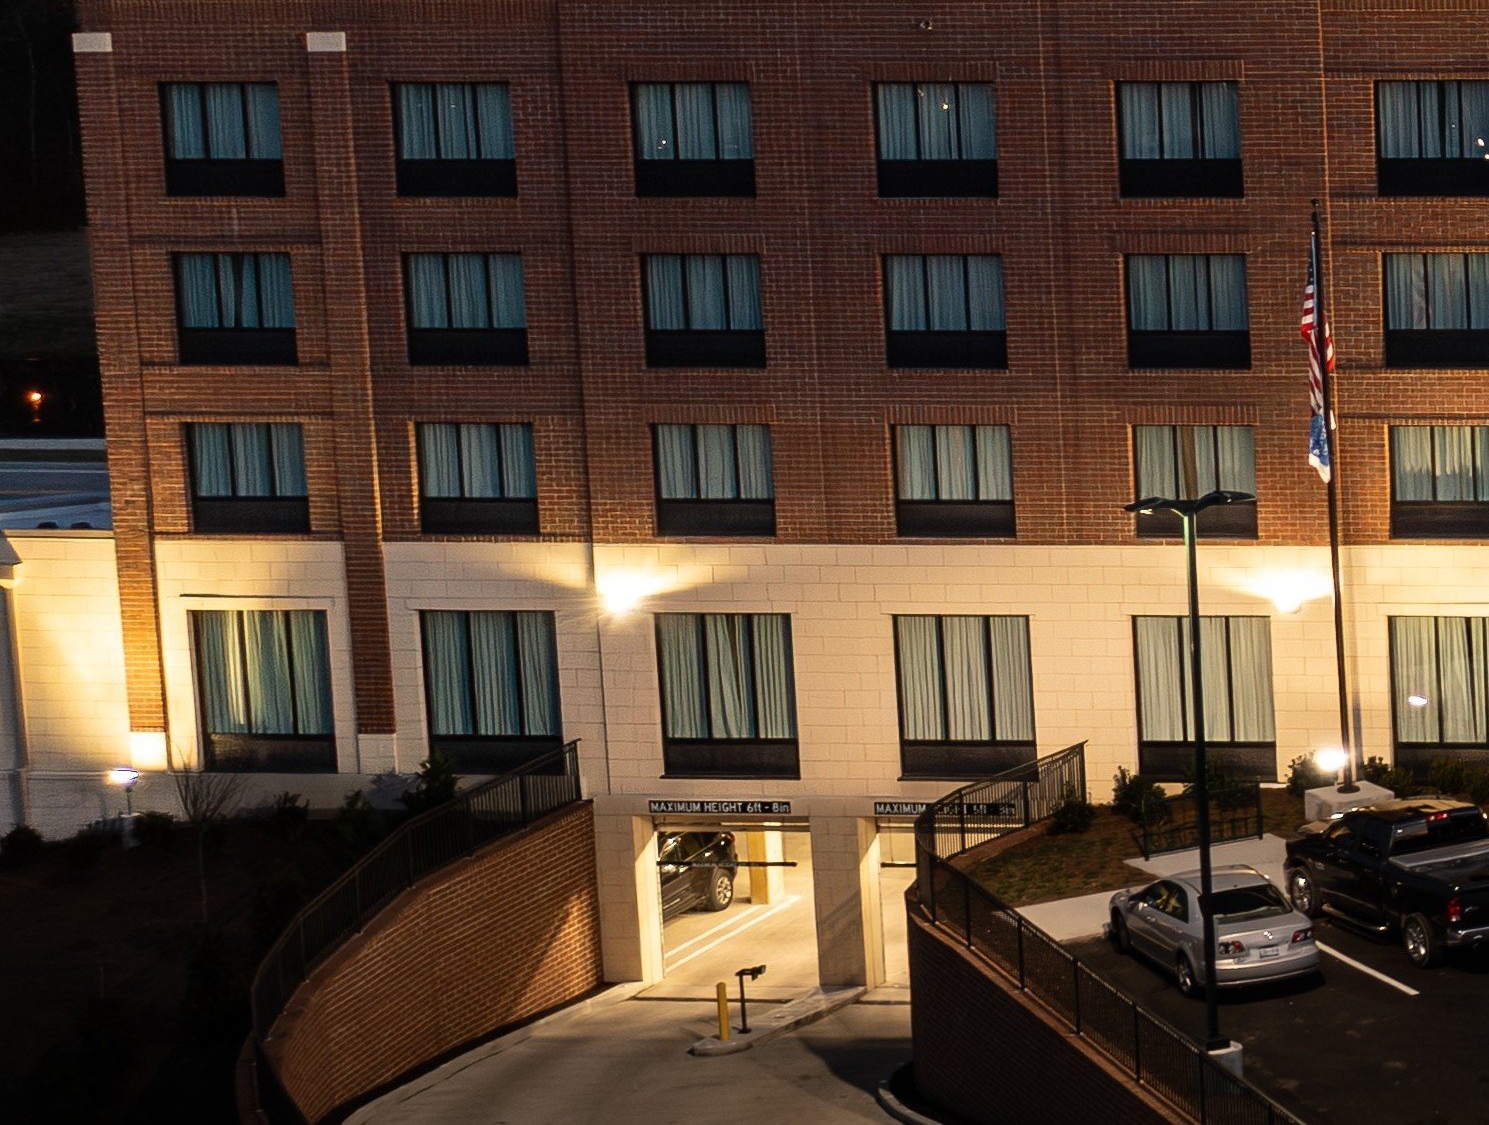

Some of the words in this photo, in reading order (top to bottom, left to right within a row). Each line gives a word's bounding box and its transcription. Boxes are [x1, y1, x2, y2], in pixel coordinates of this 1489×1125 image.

[651, 802, 701, 812] MAXIMUM
[703, 802, 743, 813] HEIGHT
[746, 803, 763, 813] 6ft
[772, 803, 789, 812] 8in
[876, 804, 926, 814] MAXIMUM
